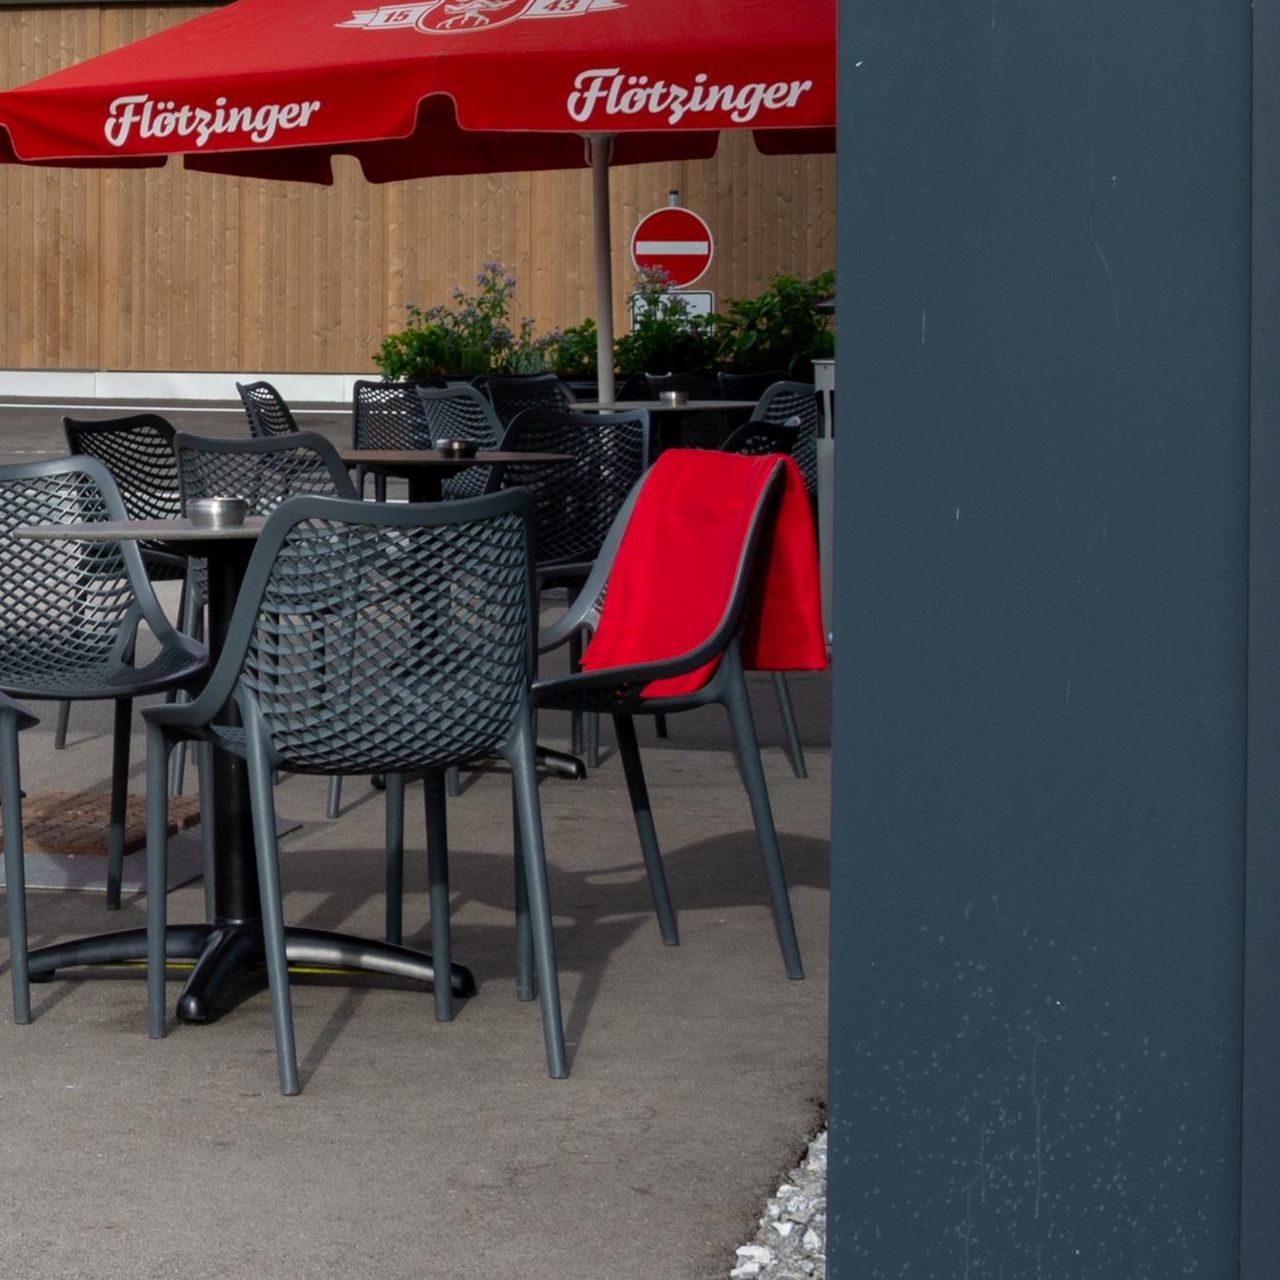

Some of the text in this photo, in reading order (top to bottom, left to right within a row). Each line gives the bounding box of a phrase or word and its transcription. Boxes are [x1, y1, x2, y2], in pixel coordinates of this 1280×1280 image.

[382, 9, 409, 24] 15
[104, 93, 321, 147] Flötzinger
[567, 67, 813, 125] Flötzinger
